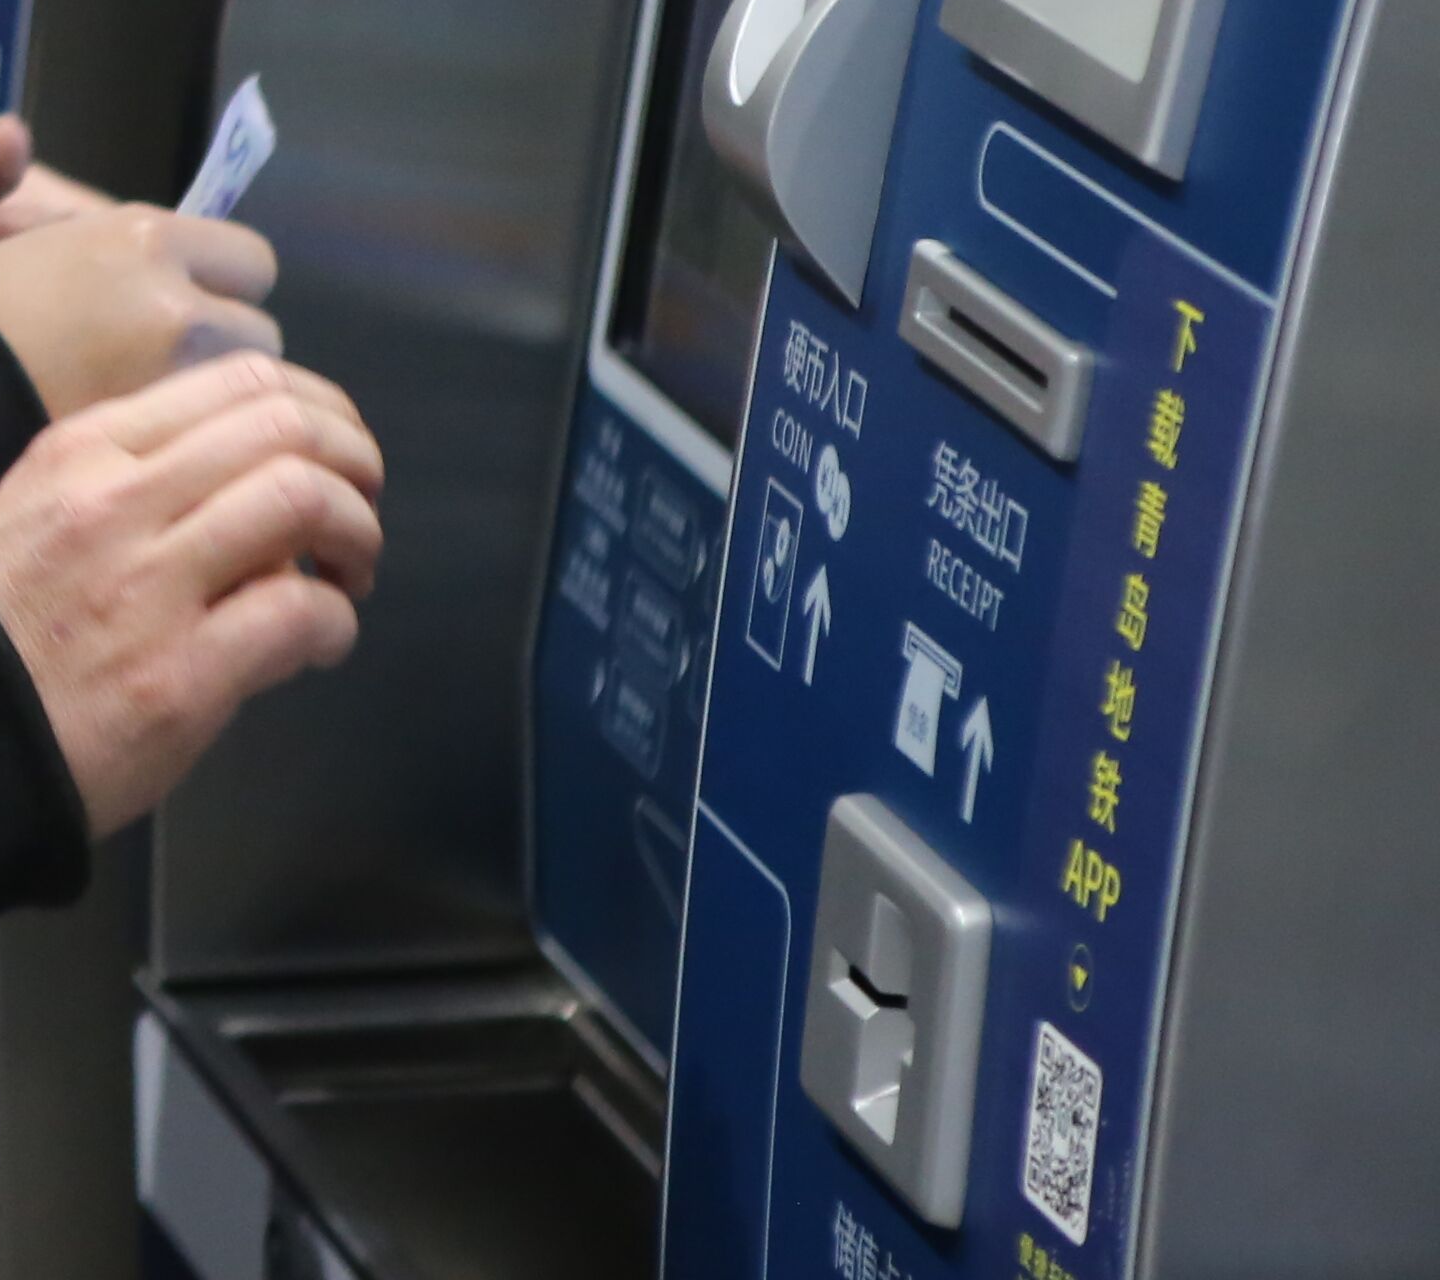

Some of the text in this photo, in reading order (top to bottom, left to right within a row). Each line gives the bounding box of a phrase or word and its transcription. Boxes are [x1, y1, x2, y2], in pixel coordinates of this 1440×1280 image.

[784, 319, 868, 440] 硬币入口
[773, 407, 813, 474] COIN
[926, 440, 1028, 573] 凭条出口
[927, 538, 1004, 632] RECEIPT
